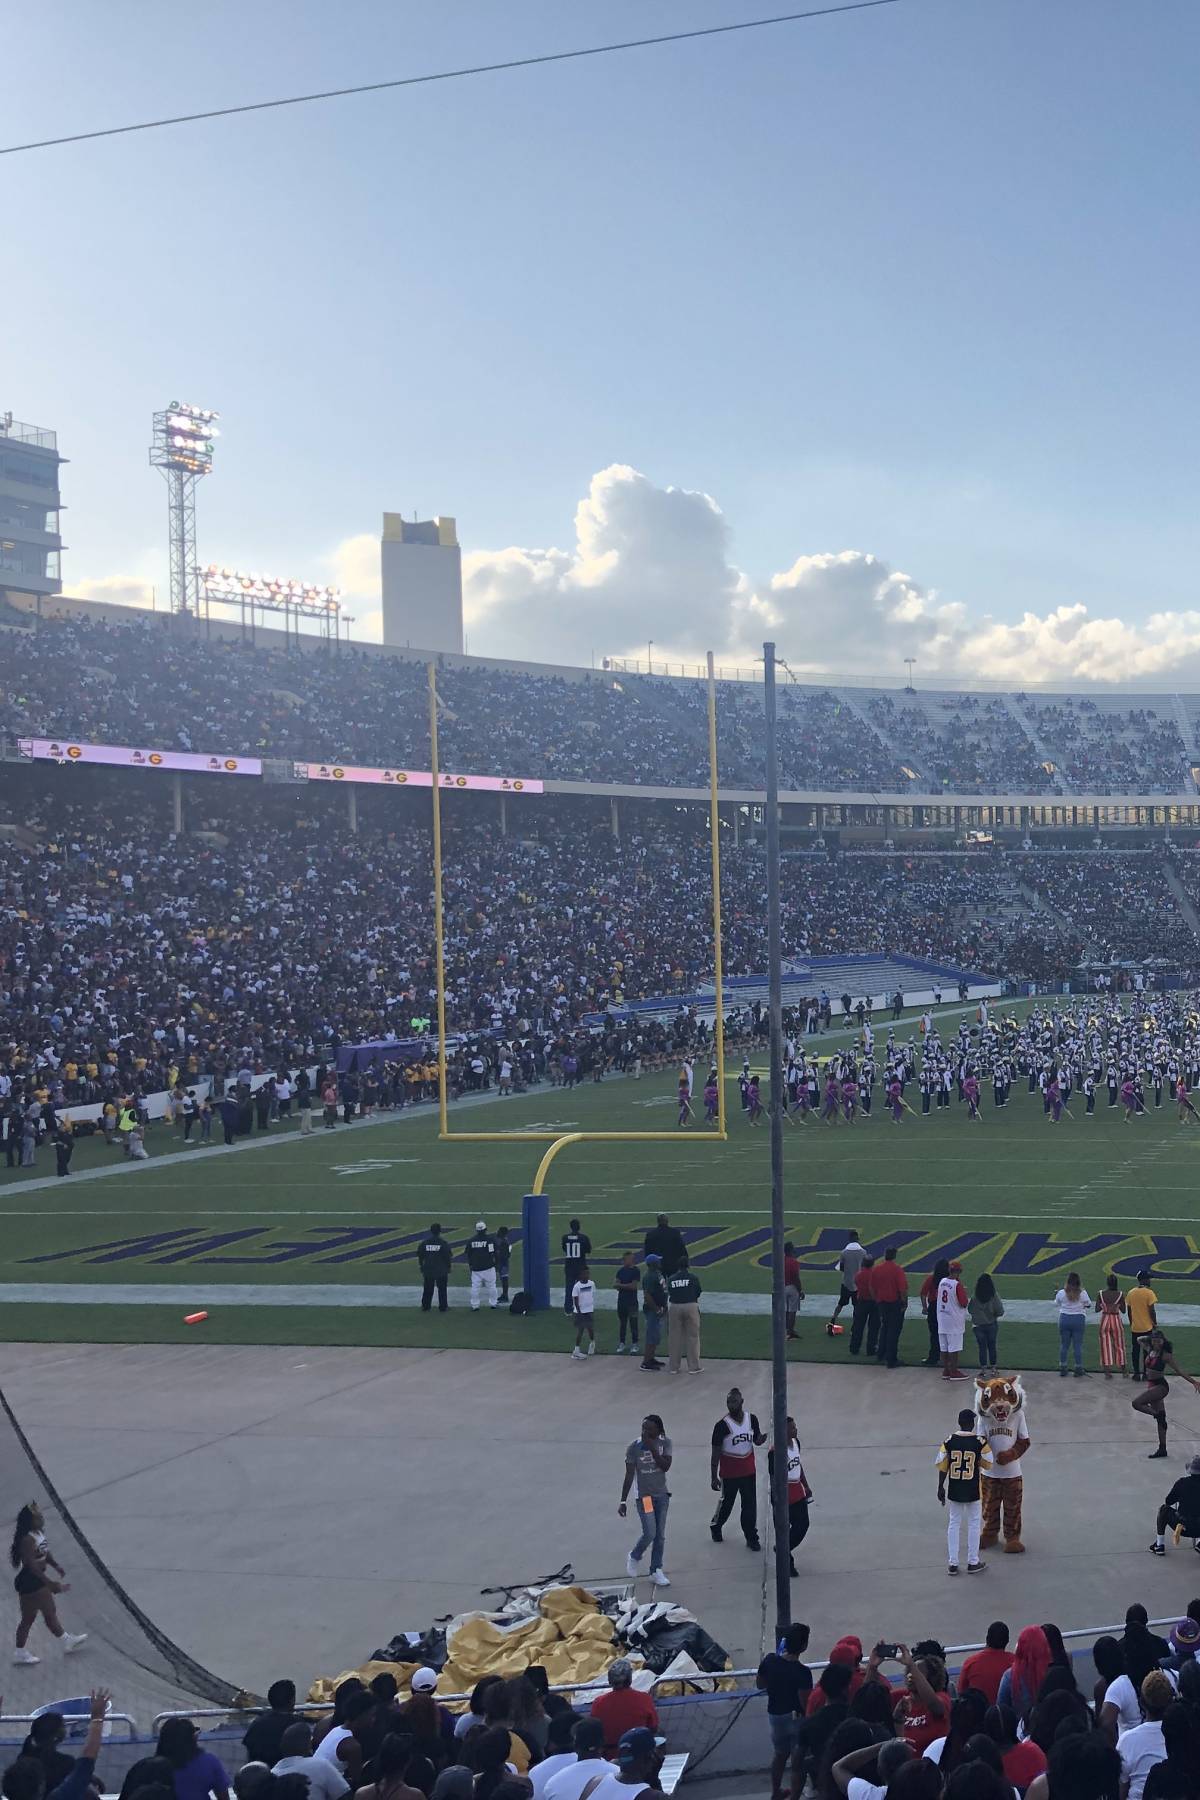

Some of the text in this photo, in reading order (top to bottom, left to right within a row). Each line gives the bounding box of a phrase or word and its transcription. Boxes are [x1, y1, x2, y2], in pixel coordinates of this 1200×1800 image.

[565, 1242, 581, 1258] 10
[671, 1279, 690, 1289] STAFF
[941, 1289, 949, 1303] 8
[732, 1433, 753, 1446] GSU
[950, 1450, 976, 1480] 23
